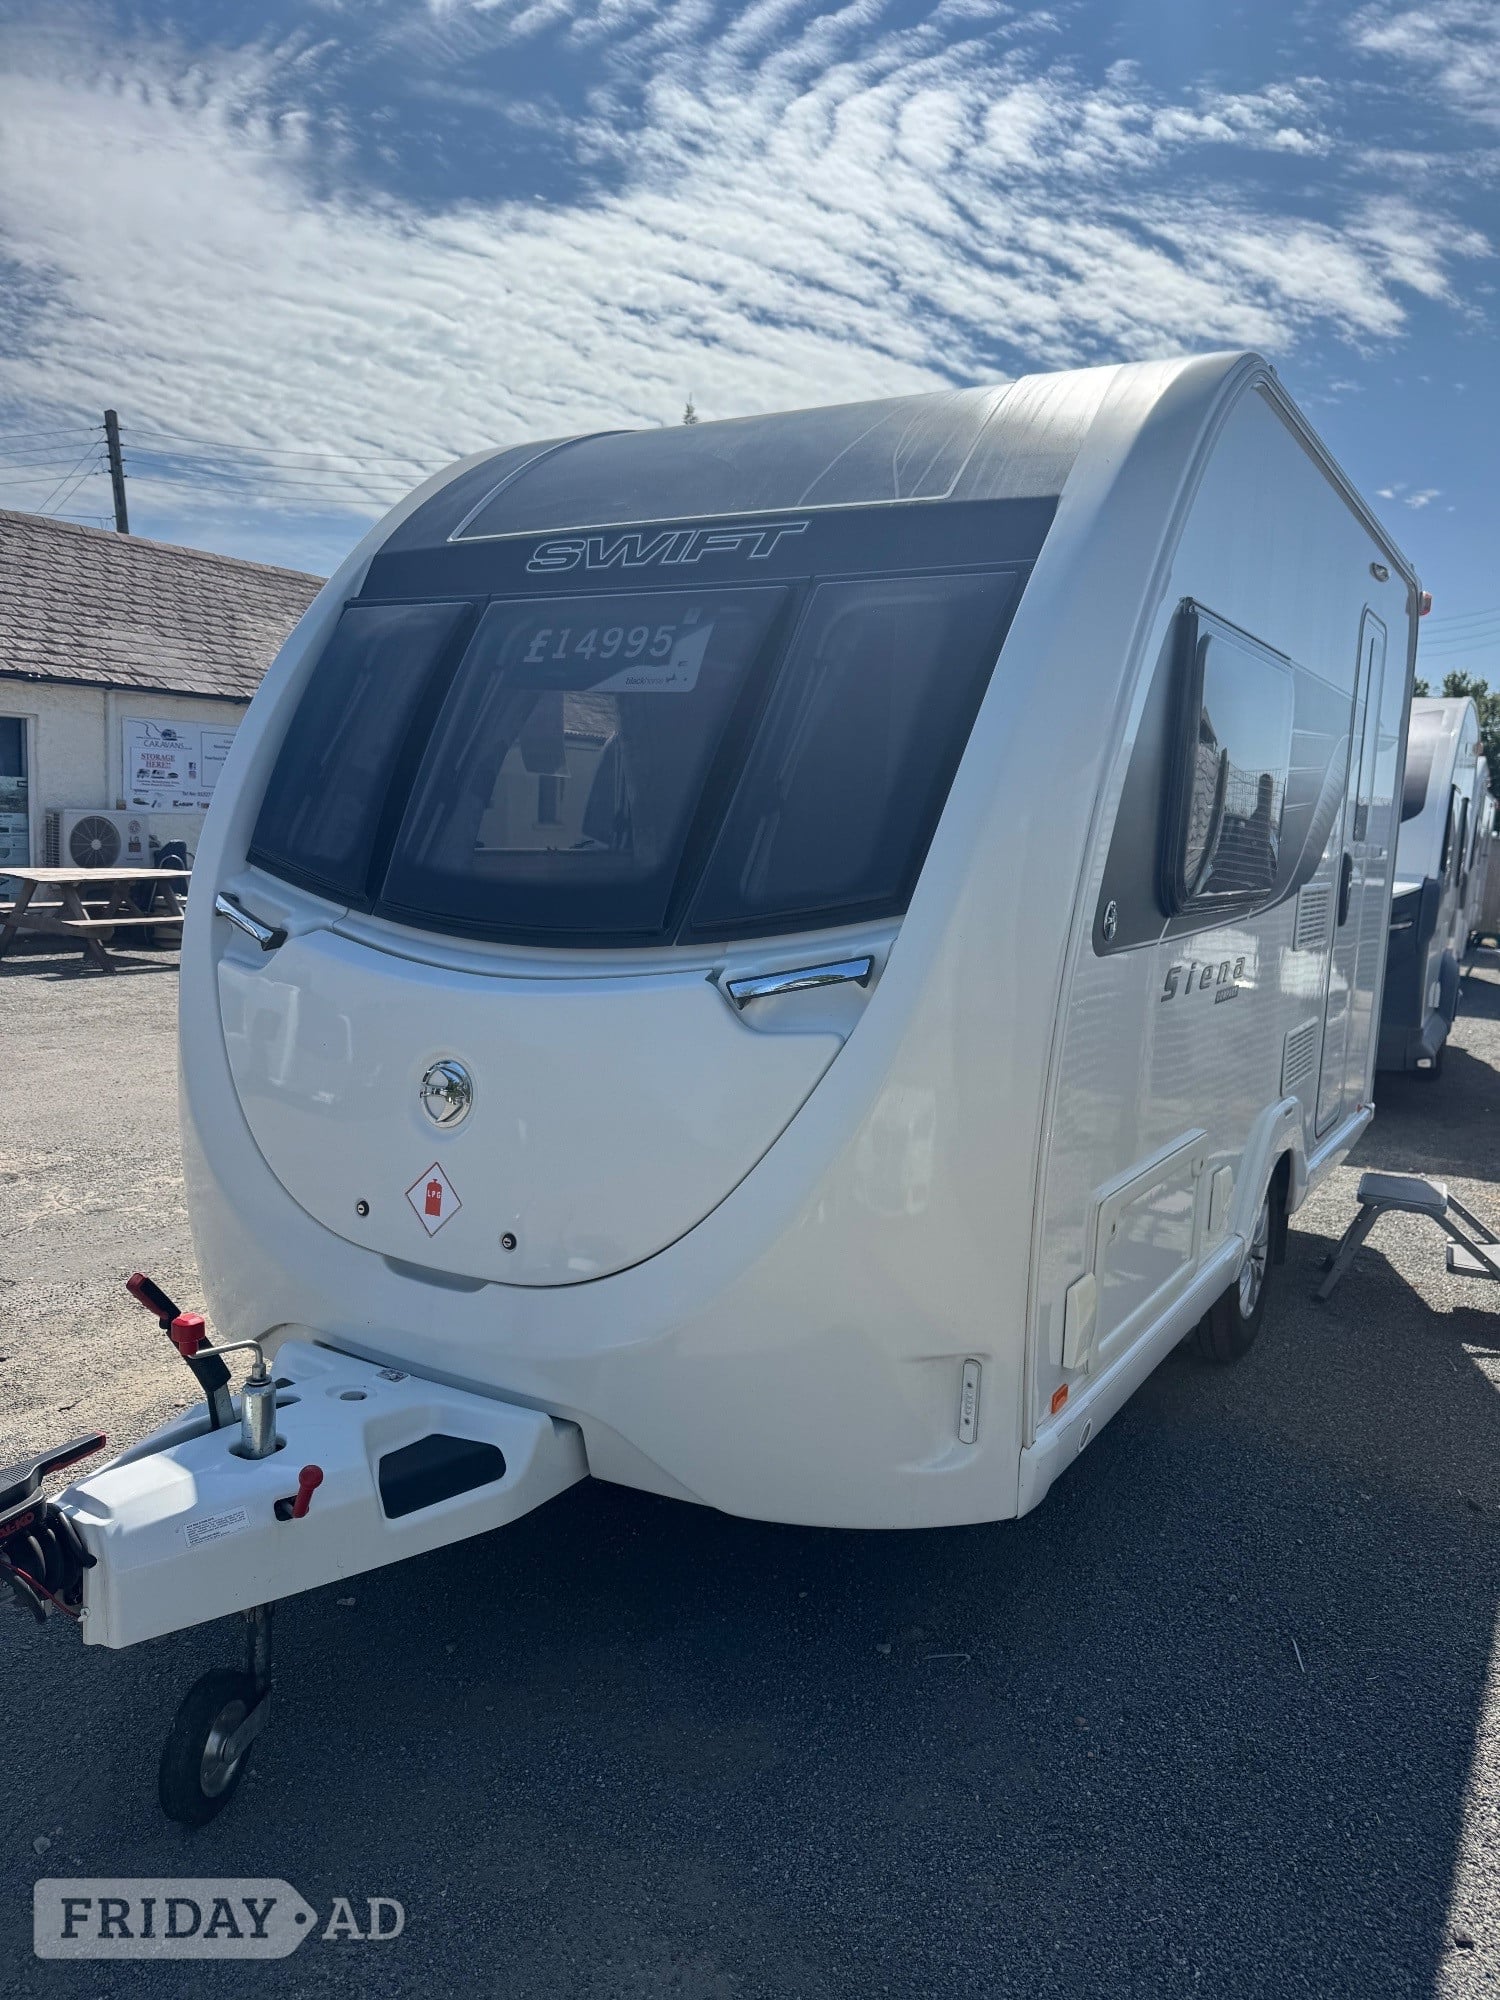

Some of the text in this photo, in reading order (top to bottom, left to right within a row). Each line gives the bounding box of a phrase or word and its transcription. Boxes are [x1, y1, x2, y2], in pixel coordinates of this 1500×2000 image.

[527, 521, 810, 572] SWIFT
[524, 626, 674, 662] £14995
[143, 740, 184, 749] CARAVANS
[141, 752, 176, 762] STORAGE
[1160, 957, 1246, 1003] Siena
[427, 1190, 441, 1199] LPG
